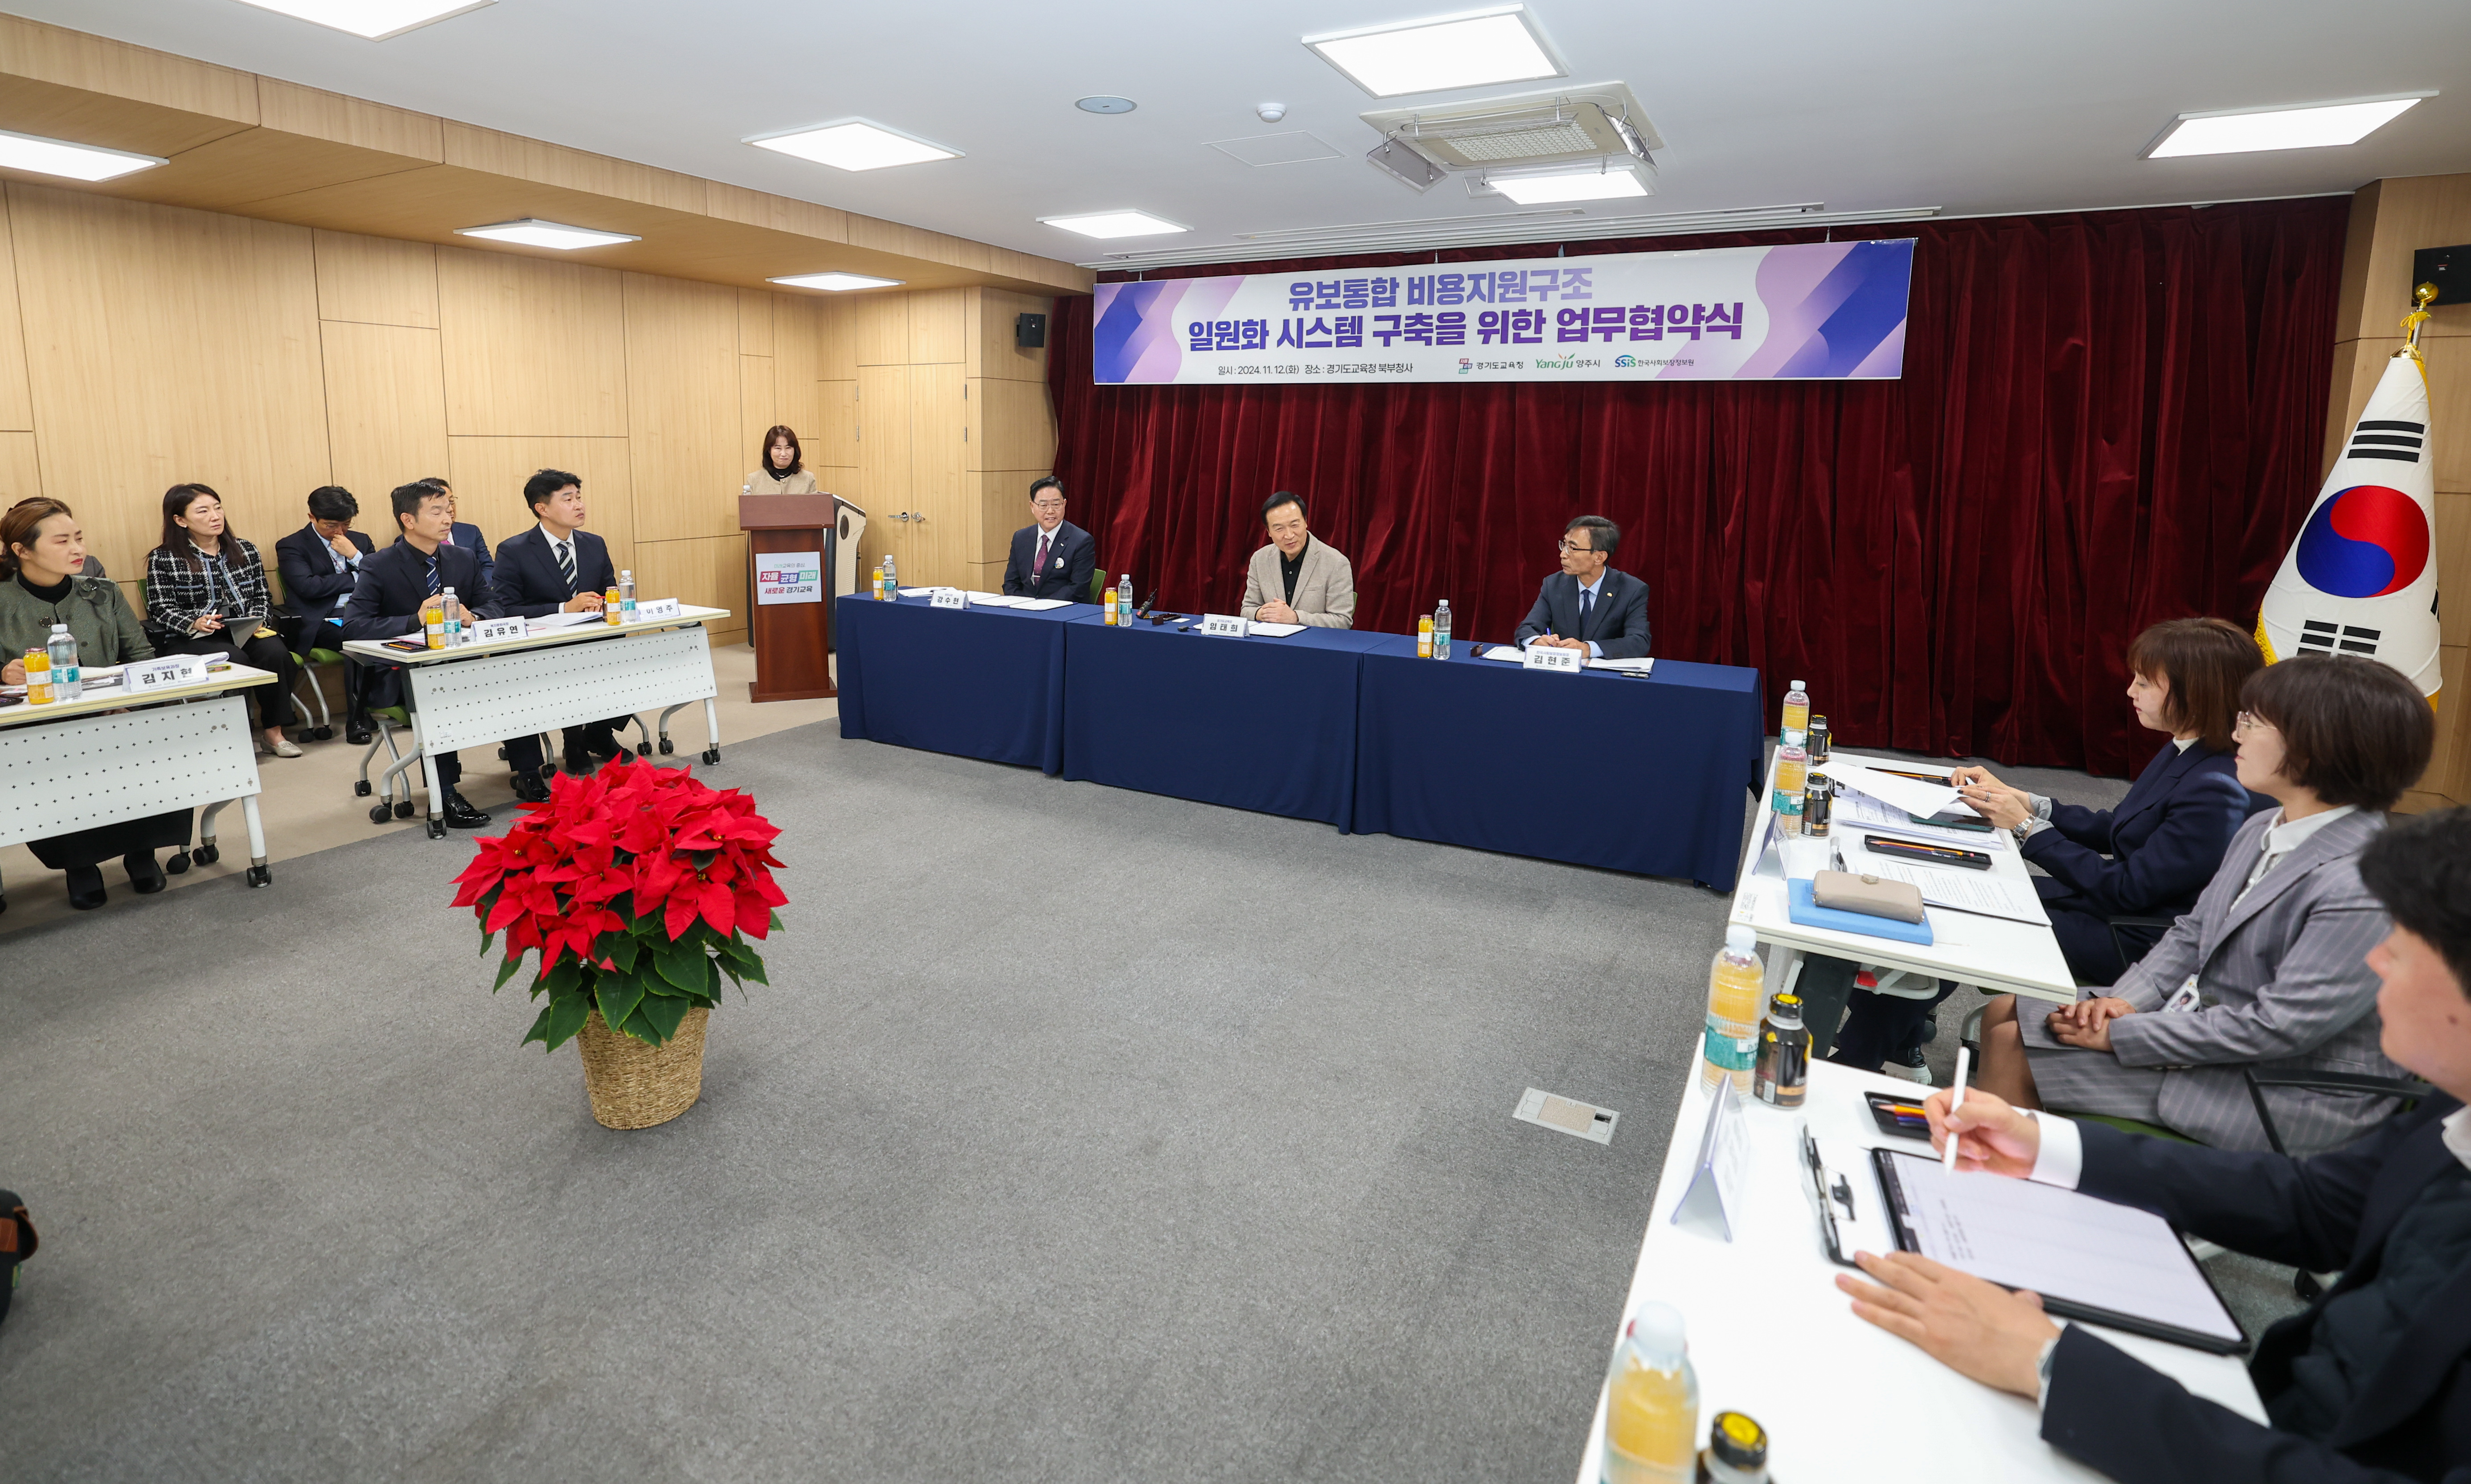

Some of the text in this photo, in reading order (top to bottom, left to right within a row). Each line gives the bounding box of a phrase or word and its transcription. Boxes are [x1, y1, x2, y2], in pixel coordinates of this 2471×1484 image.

[1289, 267, 1593, 312] 유보통합 비용지원구조
[1188, 302, 1744, 352] 일원화 시스템 구축을 위한 업무협약식
[1238, 365, 1262, 375] 2024.
[1274, 364, 1299, 375] 12.(화)
[1327, 363, 1377, 374] 경기도교육청
[1378, 362, 1413, 374] 북부청사
[1476, 361, 1524, 370] 경기도교육청
[1576, 359, 1601, 368] 양주시
[1638, 359, 1694, 367] 한국사회보장정보원
[761, 570, 816, 583] 자율 균형 미래
[786, 585, 812, 593] 경기교육
